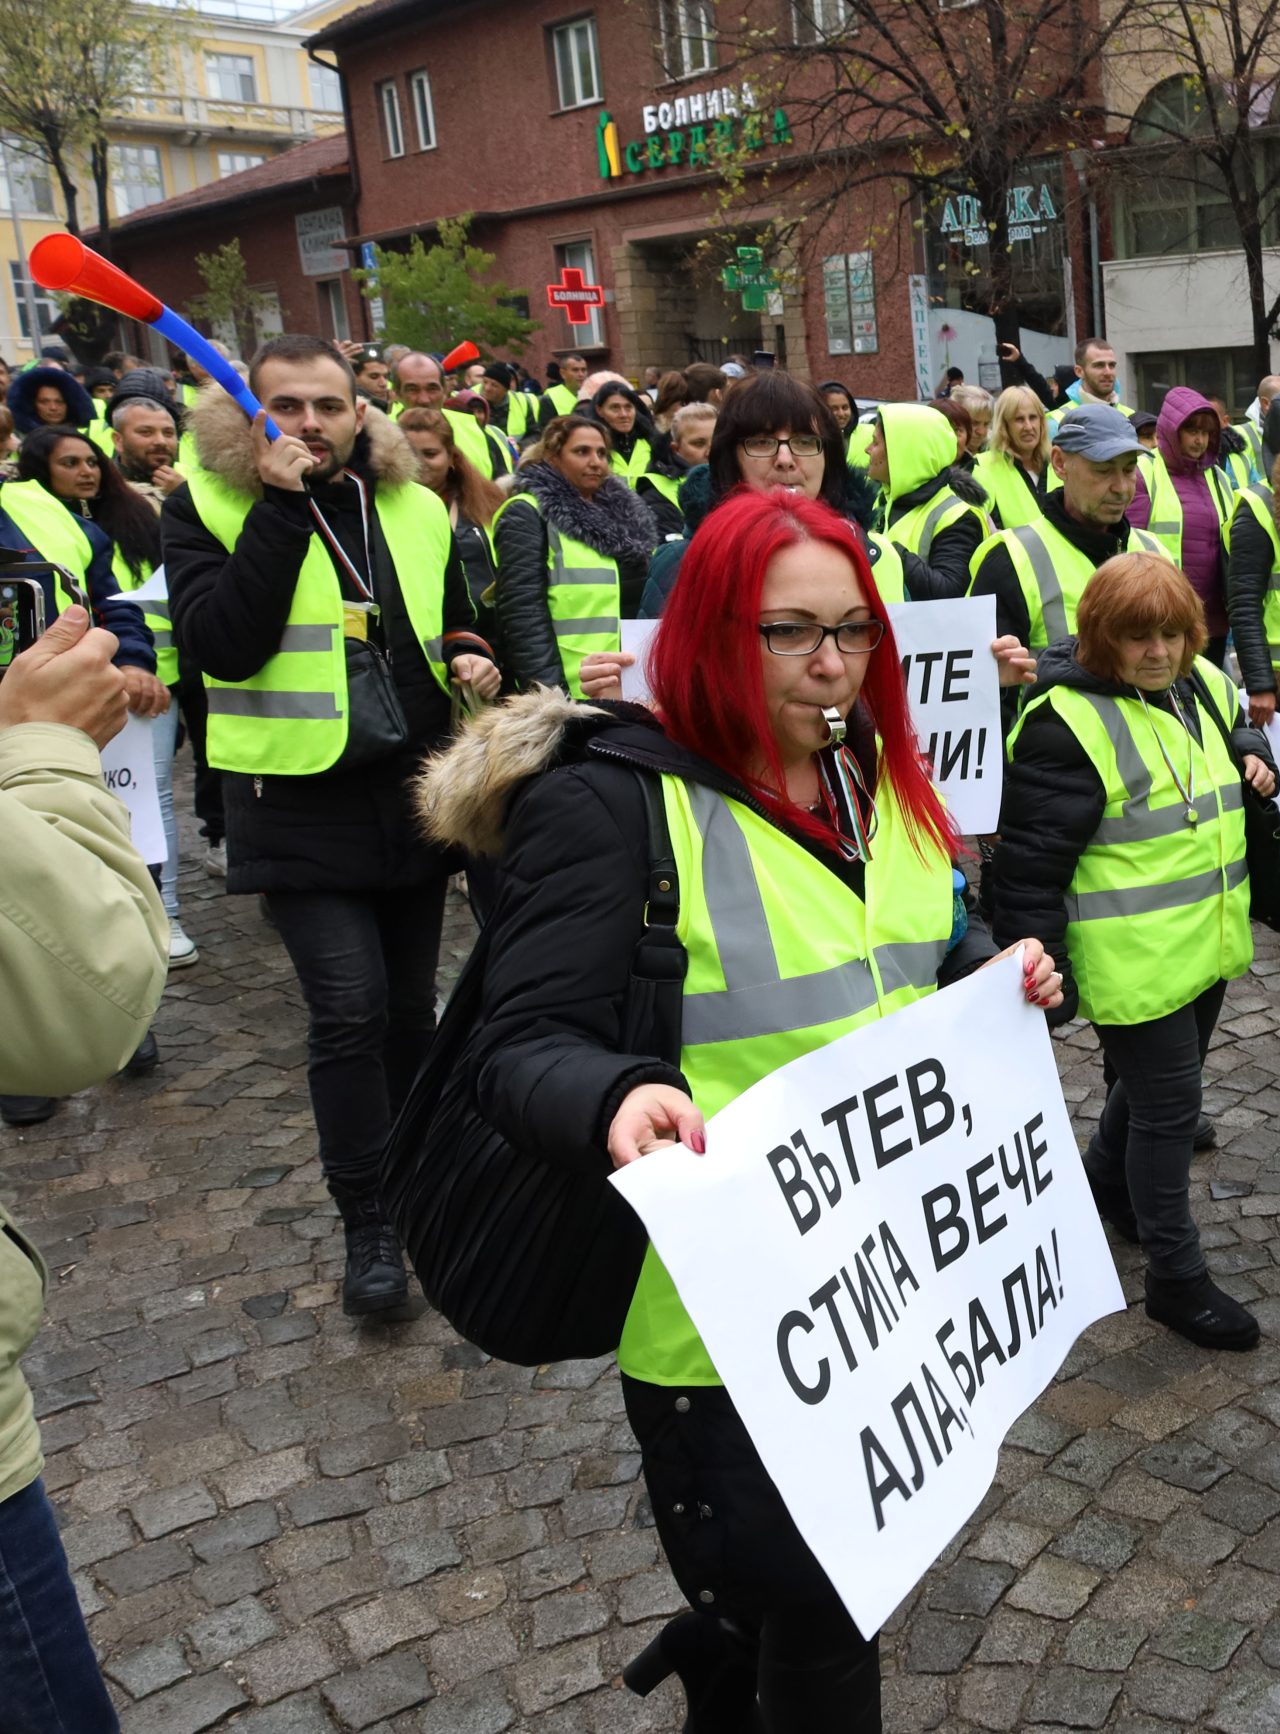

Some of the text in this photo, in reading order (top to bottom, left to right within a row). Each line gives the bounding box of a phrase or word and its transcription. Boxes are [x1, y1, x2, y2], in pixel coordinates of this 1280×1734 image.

[643, 82, 757, 133] БОЛНИЦА
[553, 291, 598, 302] БОЛНИЦА
[766, 1058, 972, 1237] ВЪТЕВ,
[777, 1112, 1053, 1405] СТИГА ВЕЧЕ
